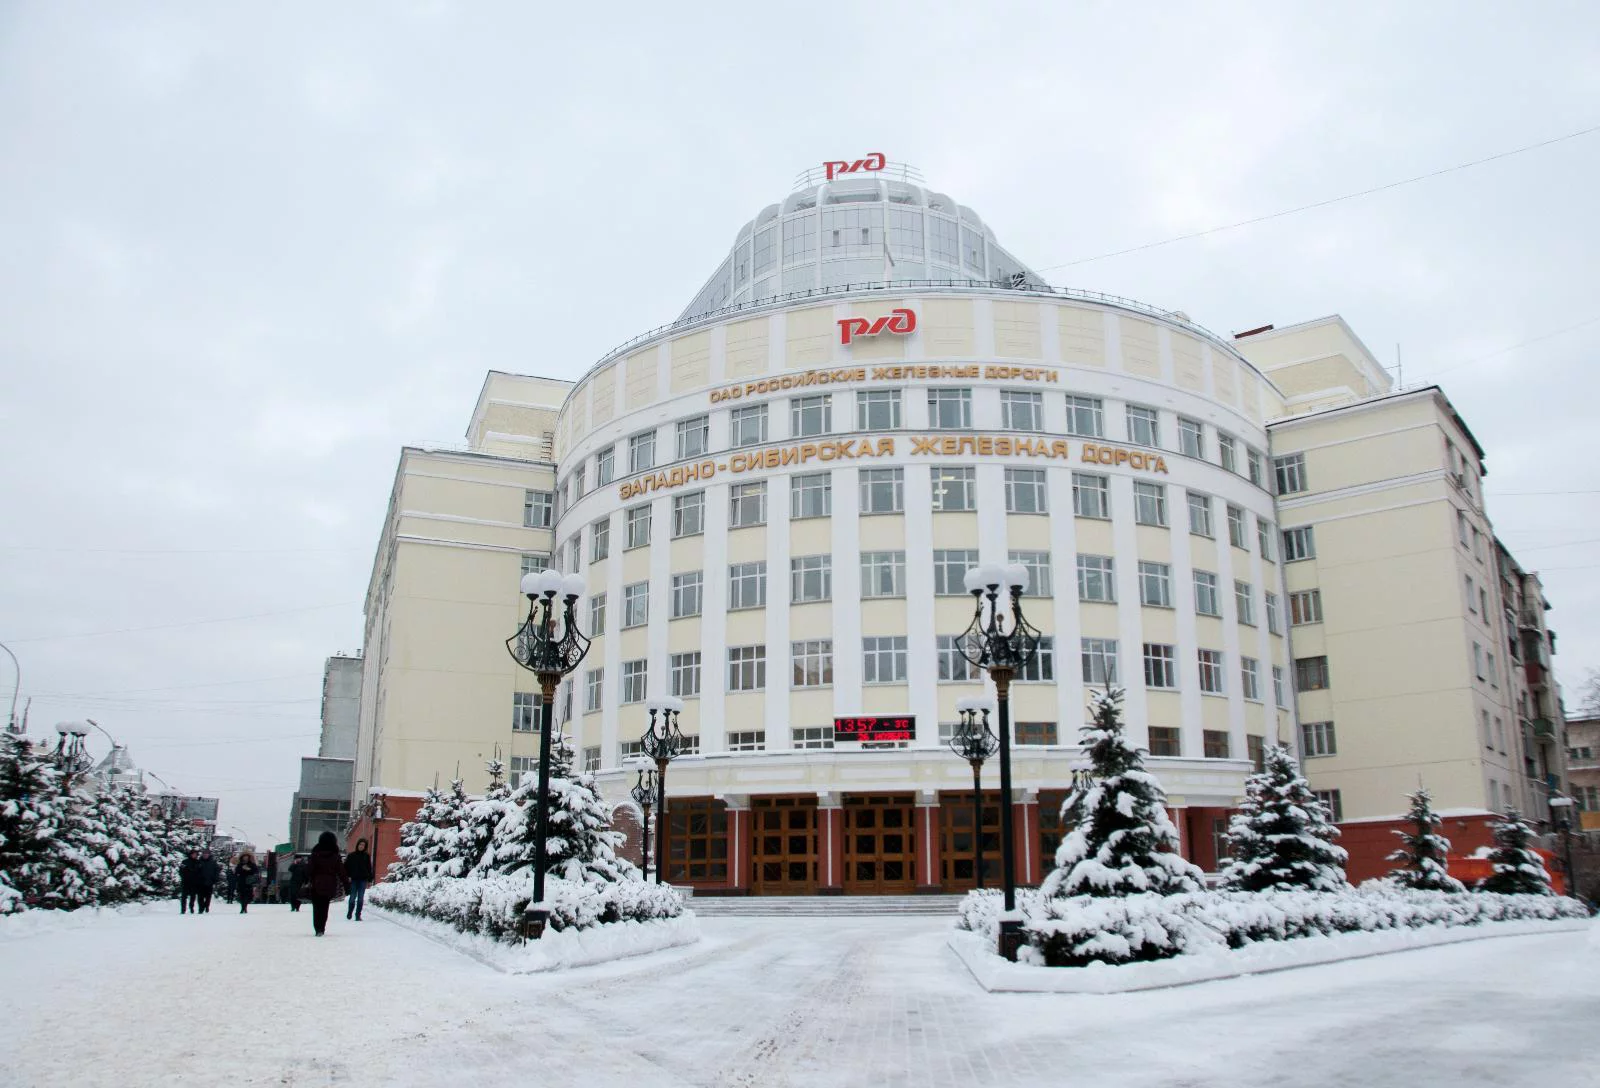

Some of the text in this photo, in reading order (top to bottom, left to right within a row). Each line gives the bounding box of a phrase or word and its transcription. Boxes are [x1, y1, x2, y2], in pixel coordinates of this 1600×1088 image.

[709, 364, 1059, 403] ОАО РОССИЙСКИЕ ЖЕЛЕЗНЫЕ ДОРОГИ
[619, 435, 1169, 500] ЗАПАДНО-СИБИРСКАЯ ЖЕЛЕЗНАЯ ДОРОГА
